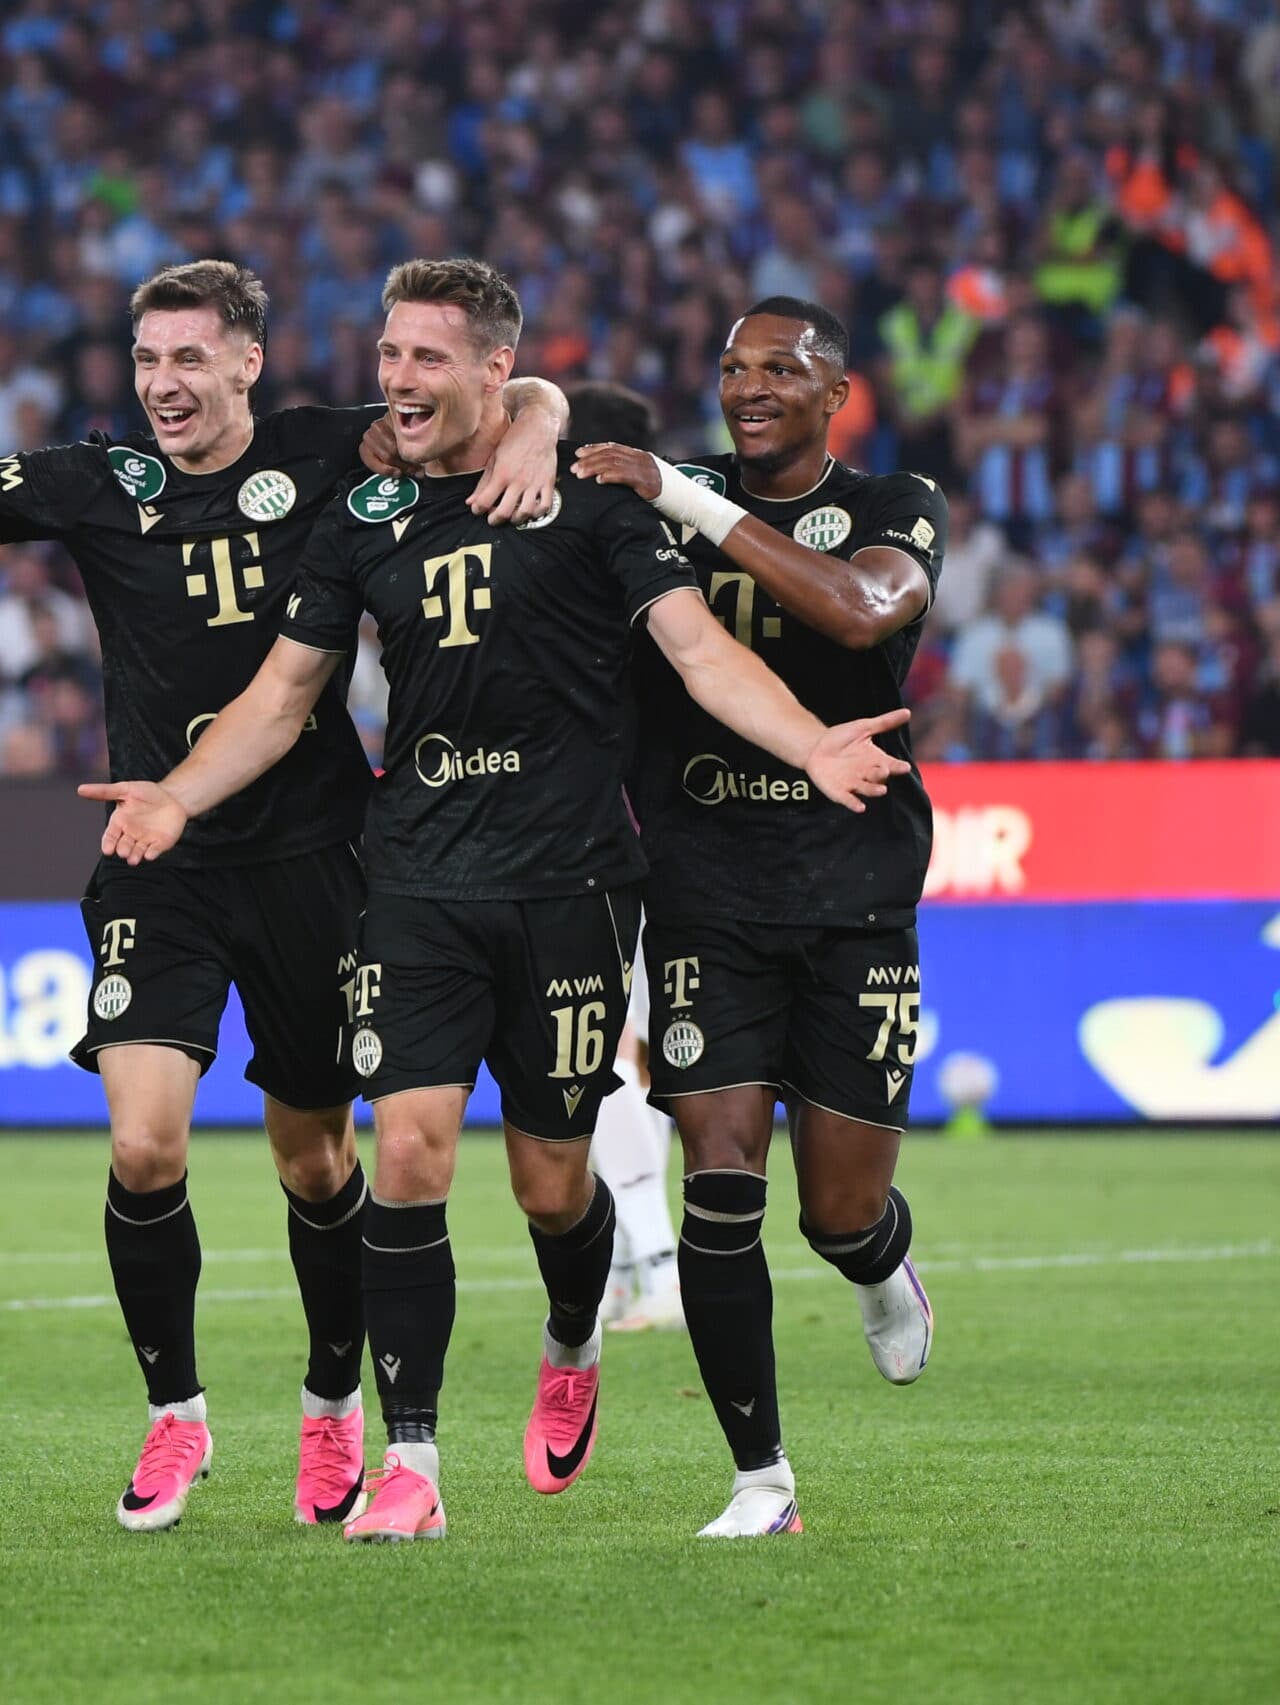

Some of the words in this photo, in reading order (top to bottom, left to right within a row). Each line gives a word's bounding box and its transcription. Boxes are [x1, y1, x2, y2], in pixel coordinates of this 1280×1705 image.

[415, 733, 520, 787] Midea
[682, 753, 809, 805] Midea
[546, 974, 604, 997] MVM
[547, 1001, 606, 1078] 16
[858, 992, 920, 1065] 75
